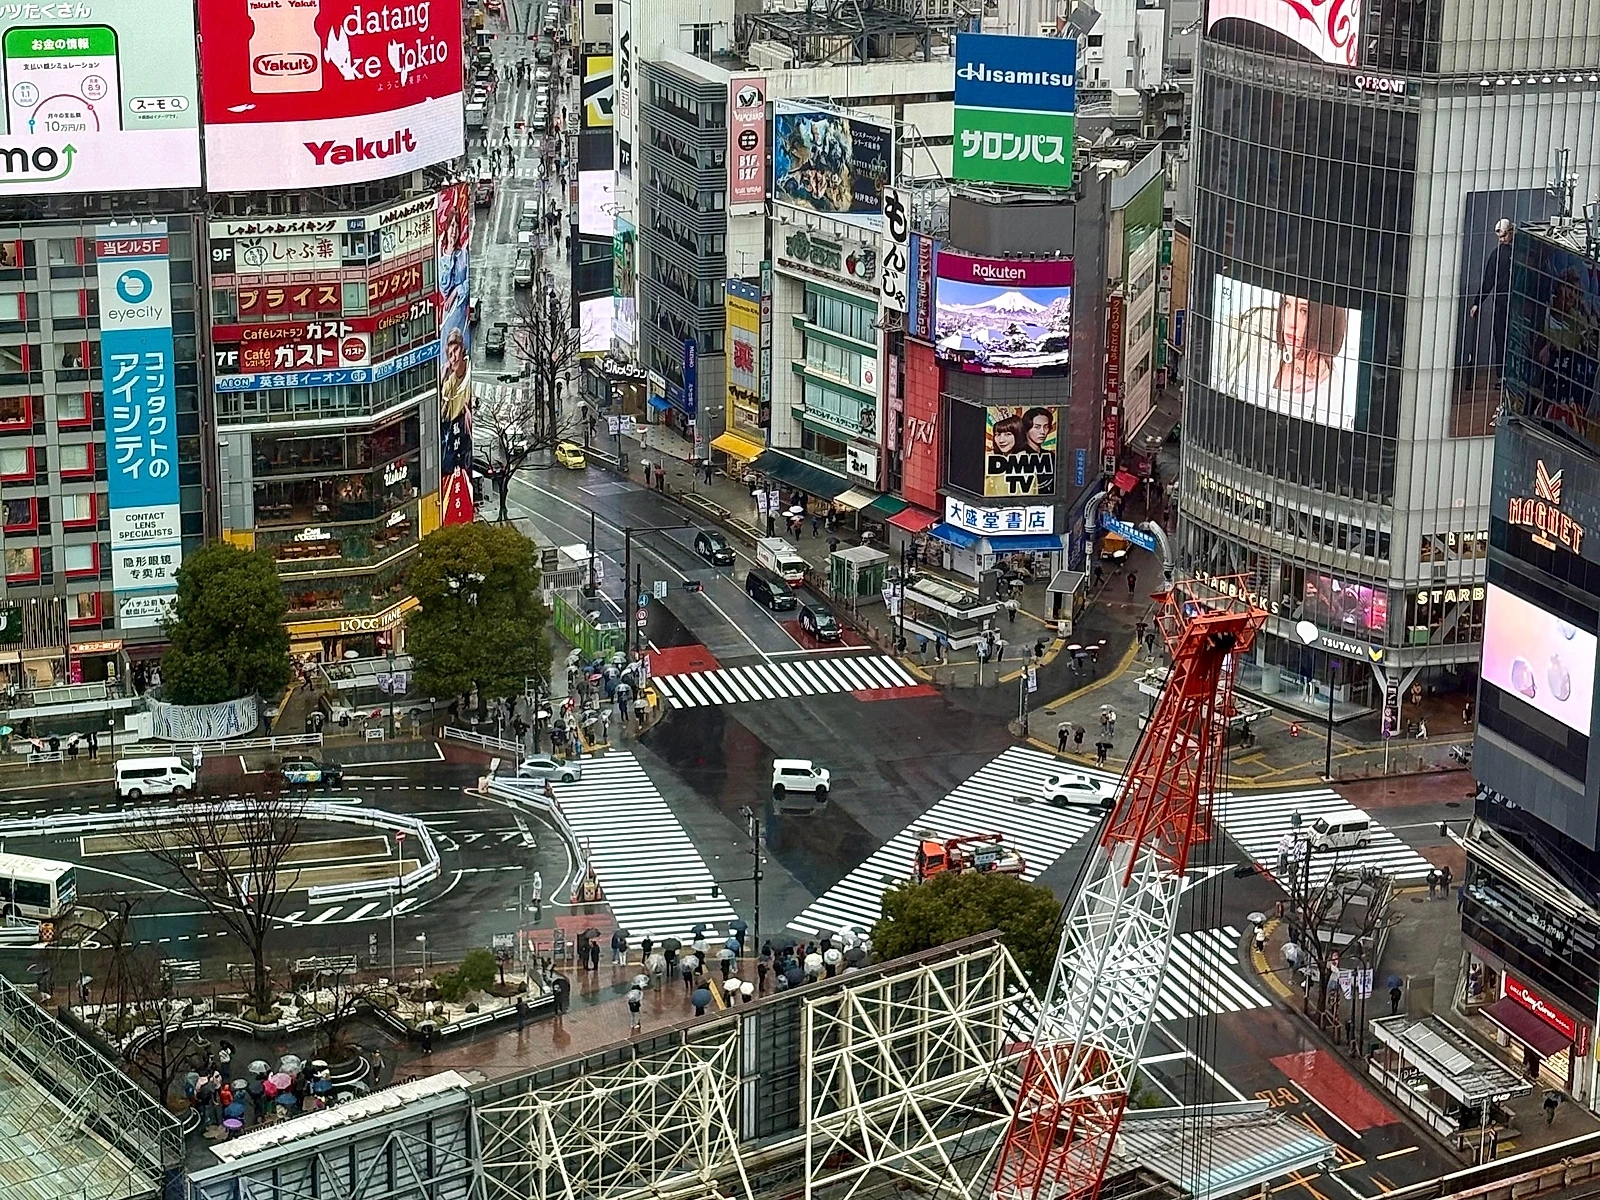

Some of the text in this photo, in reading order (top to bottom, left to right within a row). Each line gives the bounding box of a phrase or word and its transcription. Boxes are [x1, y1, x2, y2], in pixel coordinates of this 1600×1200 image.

[0, 3, 91, 19] ツたくさん
[343, 1, 430, 36] datang
[31, 38, 90, 50] お金の情報
[261, 59, 310, 72] Yakult
[957, 63, 1074, 88] Hisamitsu
[1355, 75, 1406, 93] QFRONT
[137, 99, 166, 110] スーモ
[45, 121, 86, 132] 10万円/月
[303, 128, 417, 166] Yakult
[960, 128, 1065, 165] サロンパス
[227, 219, 338, 236] しゃぶしゃぶバイキング
[398, 216, 432, 244] しゃぶ葉
[103, 239, 162, 255] 当ビル5F
[212, 248, 232, 262] 9F
[271, 239, 334, 260] しゃぶ葉
[881, 189, 908, 310] もんじゃ
[972, 264, 1026, 279] Rakuten
[368, 266, 421, 300] コンタクト
[239, 286, 339, 310] プライス
[108, 305, 163, 323] eyecity
[409, 299, 434, 321] ガスト
[306, 321, 353, 339] ガスト
[215, 350, 239, 367] 7F
[244, 349, 271, 361] Café
[274, 344, 333, 369] ガスト
[110, 353, 145, 480] アイシティ
[145, 351, 170, 479] コンタクトの
[906, 412, 937, 459] クスリ
[988, 453, 1054, 475] DMM
[1005, 475, 1036, 494] TV
[125, 511, 165, 521] CONTACT
[950, 502, 1046, 530] 大盛堂書店
[118, 528, 173, 539] SPECIALISTS
[134, 521, 157, 530] LENS
[1508, 497, 1584, 555] MAGNET
[123, 555, 172, 569] 隐形眼镜
[129, 567, 166, 580] 专卖店
[1194, 569, 1280, 615] STARBUCKS
[1416, 588, 1485, 605] STARB
[1321, 636, 1364, 656] TSUTAYA
